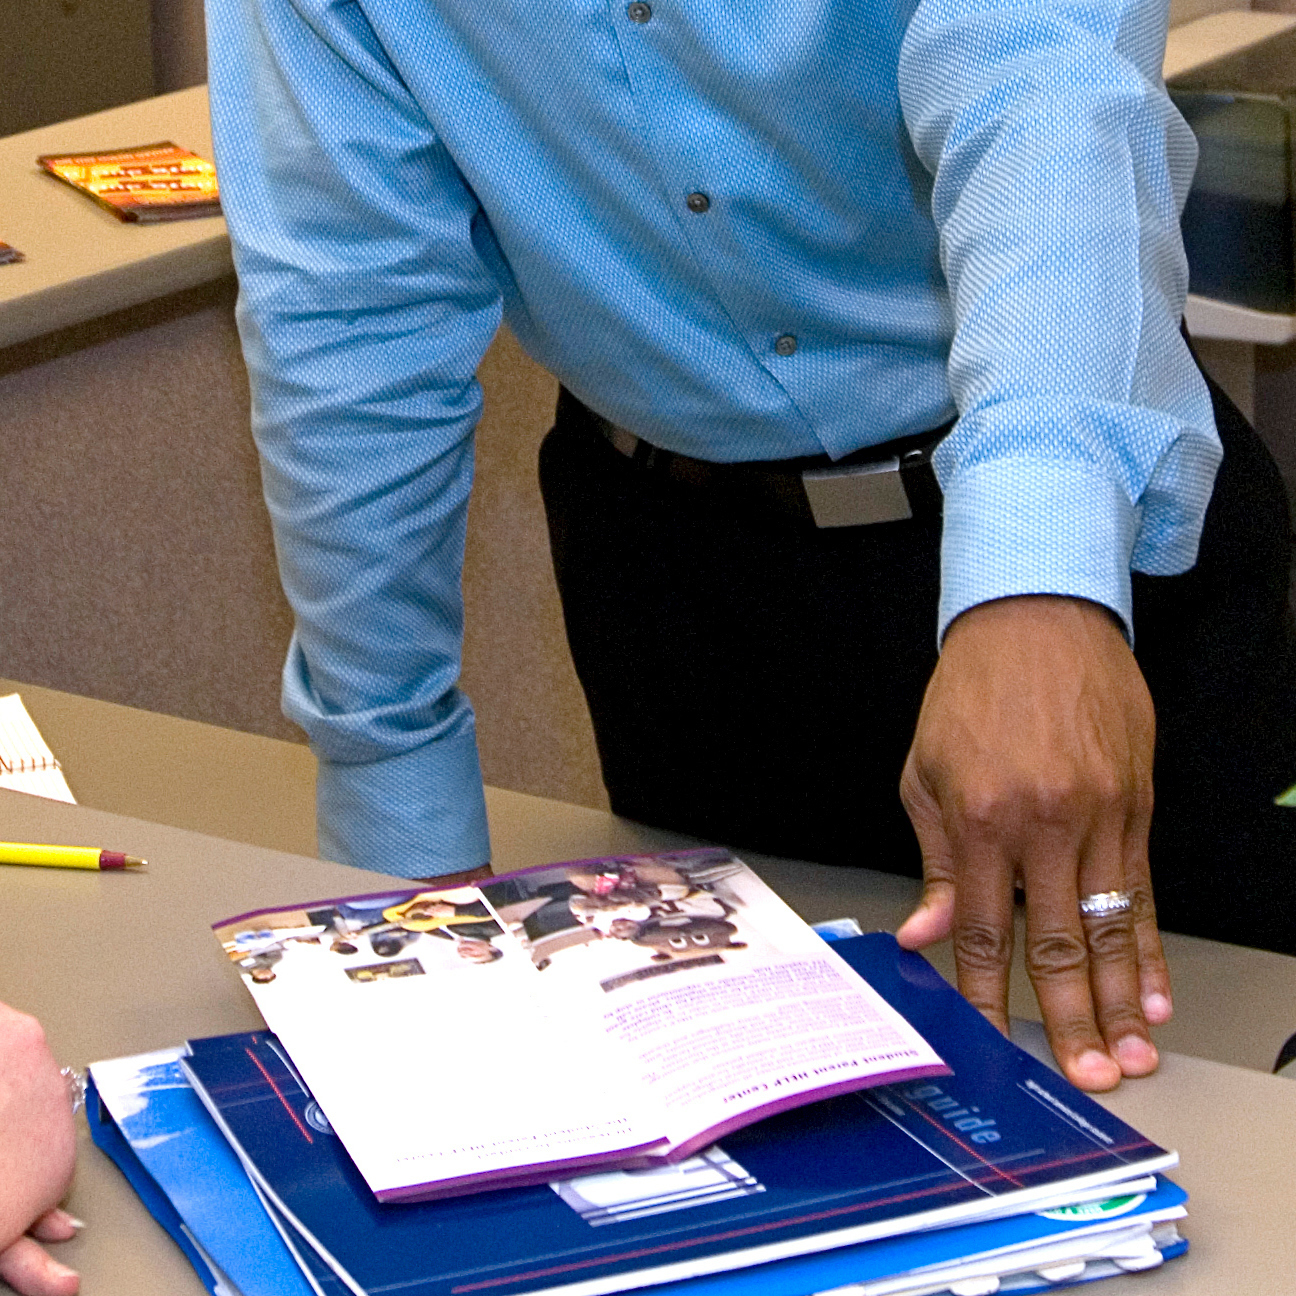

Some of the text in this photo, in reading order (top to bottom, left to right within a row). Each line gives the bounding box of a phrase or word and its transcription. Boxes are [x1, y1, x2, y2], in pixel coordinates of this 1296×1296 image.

[722, 1050, 920, 1104] Student Parent HELP Center
[904, 1085, 1002, 1144] guide
